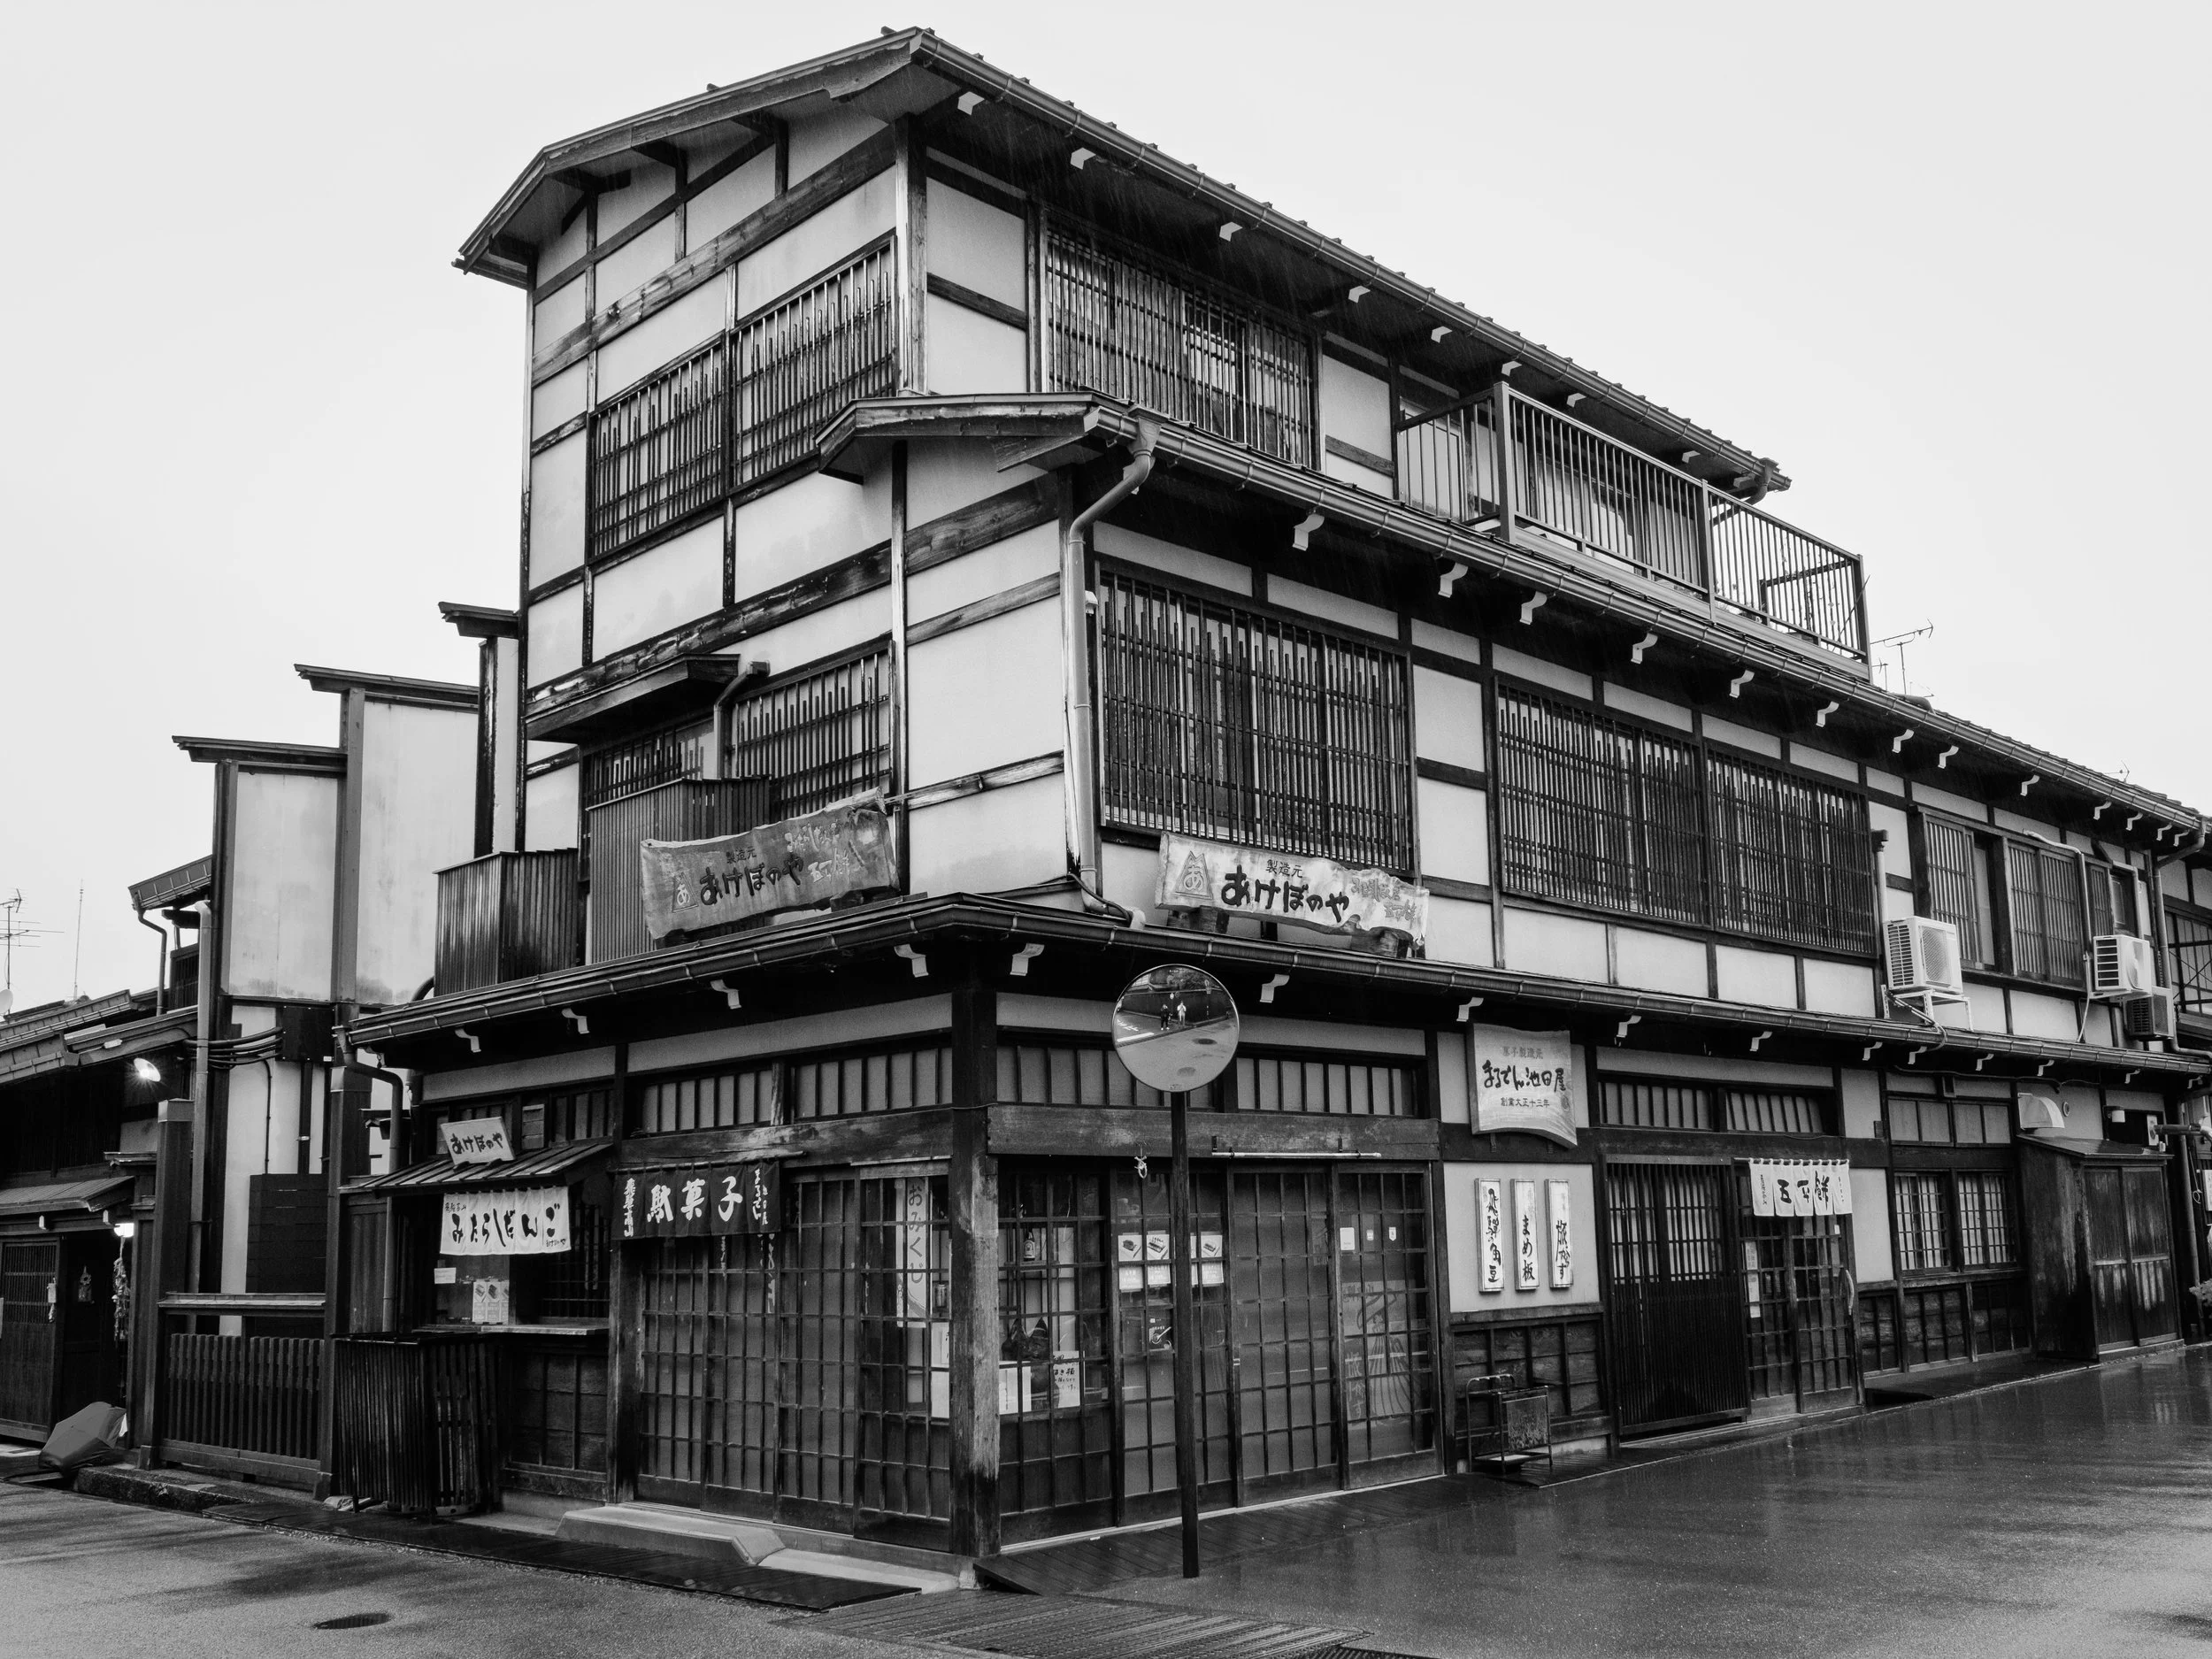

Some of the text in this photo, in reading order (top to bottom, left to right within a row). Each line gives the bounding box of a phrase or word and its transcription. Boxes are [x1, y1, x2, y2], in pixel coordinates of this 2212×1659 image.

[726, 845, 757, 864] 製造元
[1266, 858, 1303, 879] 製造元
[700, 851, 804, 906] あけぼのや
[1221, 864, 1350, 923] あけぼのや
[1501, 1097, 1550, 1108] 創業大正十三年
[449, 1132, 503, 1155] あけぼのや
[647, 1175, 743, 1224] 駄菓子
[1777, 1170, 1830, 1210] 五平餅
[451, 1203, 561, 1248] みたらしだんご
[909, 1184, 924, 1284] おみくじ
[1522, 1215, 1536, 1282] まめ板
